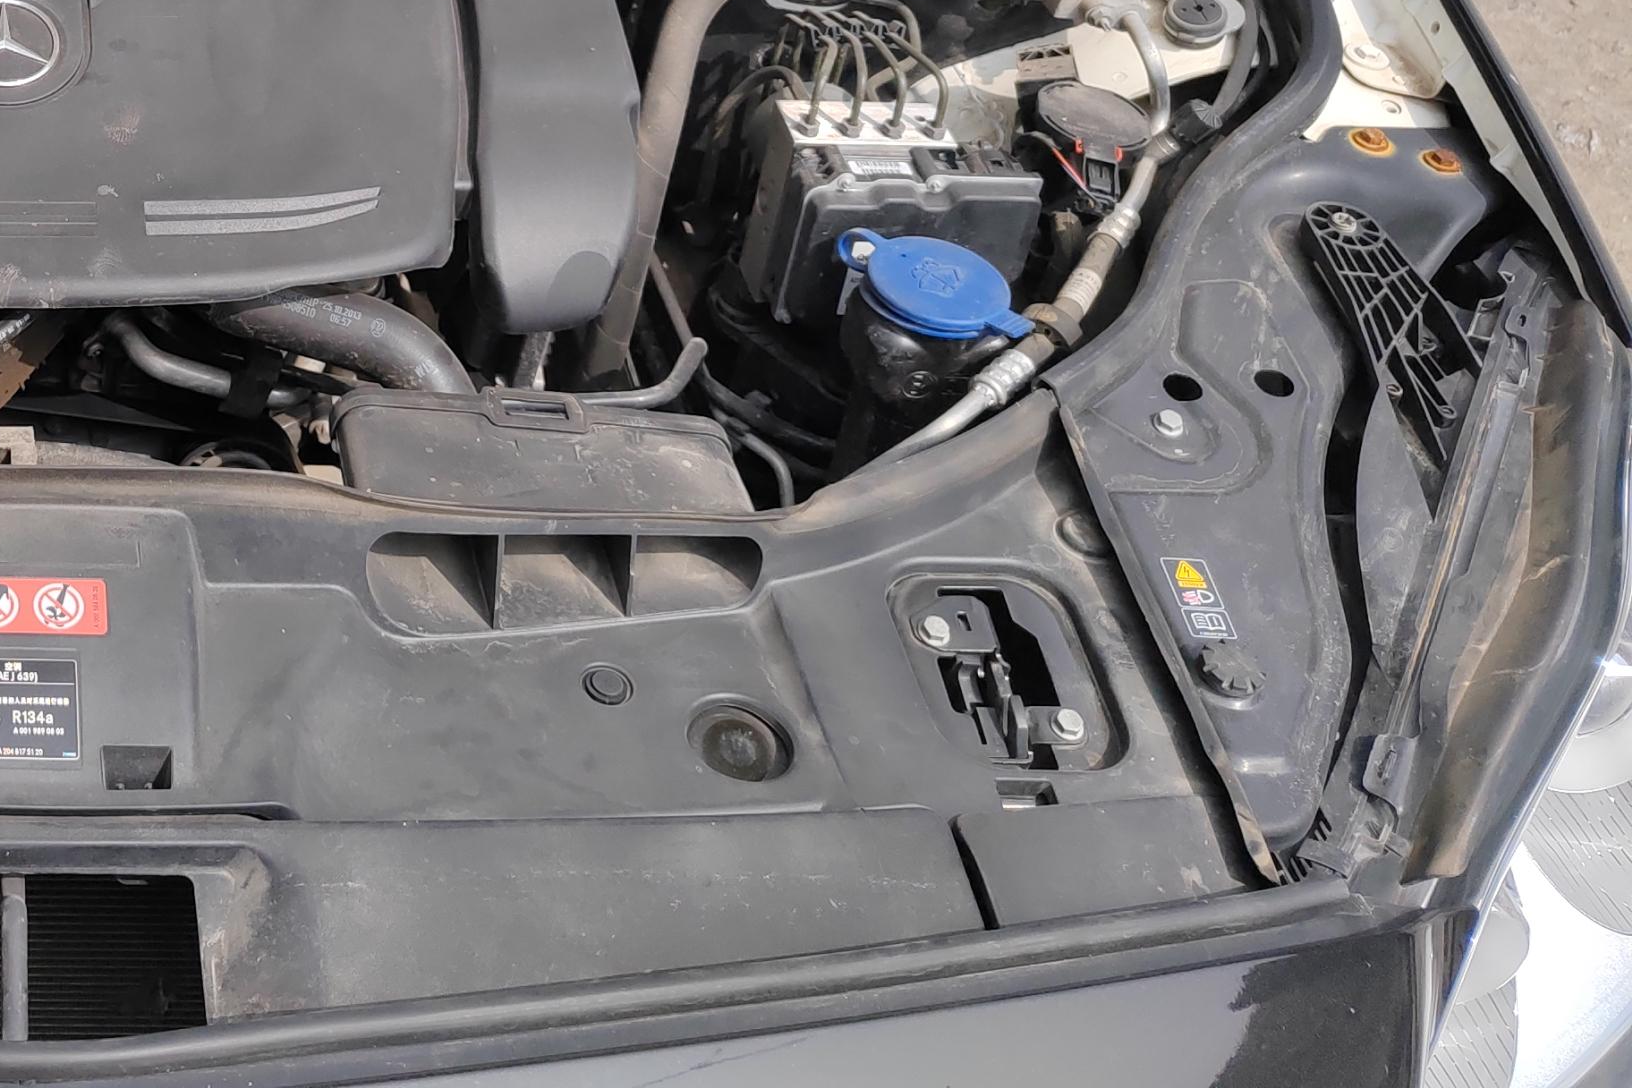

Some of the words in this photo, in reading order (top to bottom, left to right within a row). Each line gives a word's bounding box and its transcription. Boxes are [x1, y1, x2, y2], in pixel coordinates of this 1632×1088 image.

[10, 671, 15, 682] J
[17, 672, 38, 683] 639)
[12, 710, 54, 724] R134a
[13, 727, 19, 735] A
[20, 727, 31, 735] 001
